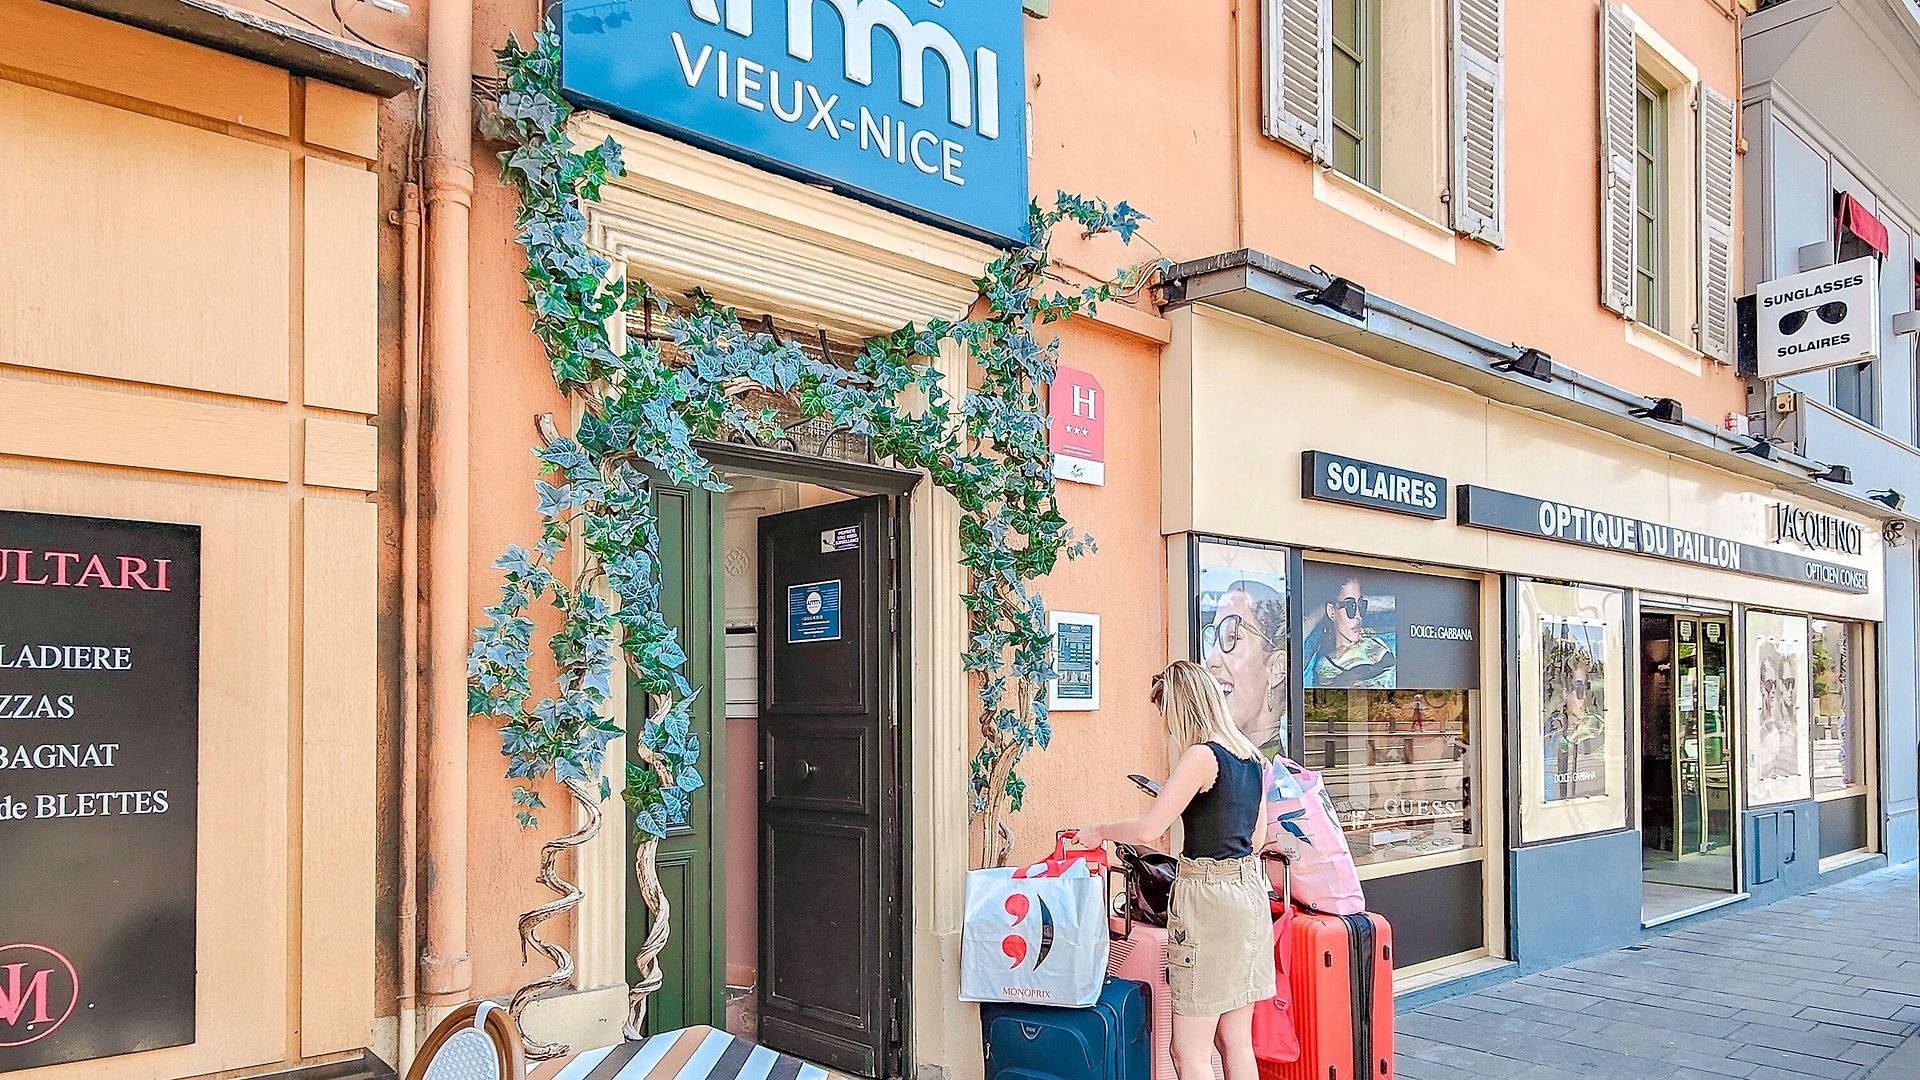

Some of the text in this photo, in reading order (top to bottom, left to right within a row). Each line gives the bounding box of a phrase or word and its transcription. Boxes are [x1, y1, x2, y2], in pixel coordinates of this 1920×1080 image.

[671, 31, 965, 186] VIEUX-NICE
[1763, 274, 1864, 308] SUNGLASSES
[1777, 333, 1851, 358] SOLAIRES
[1071, 384, 1097, 420] H
[1327, 461, 1437, 509] SOLAIRES
[1538, 501, 1741, 569] OPTIQUE DU PAILLON
[1767, 502, 1862, 555] JACQUENOT
[1805, 561, 1868, 589] OPTICIEN CONSEIL
[34, 789, 169, 819] BLETTES
[1383, 798, 1456, 816] GUESS
[1002, 986, 1051, 999] MONOPRIX
